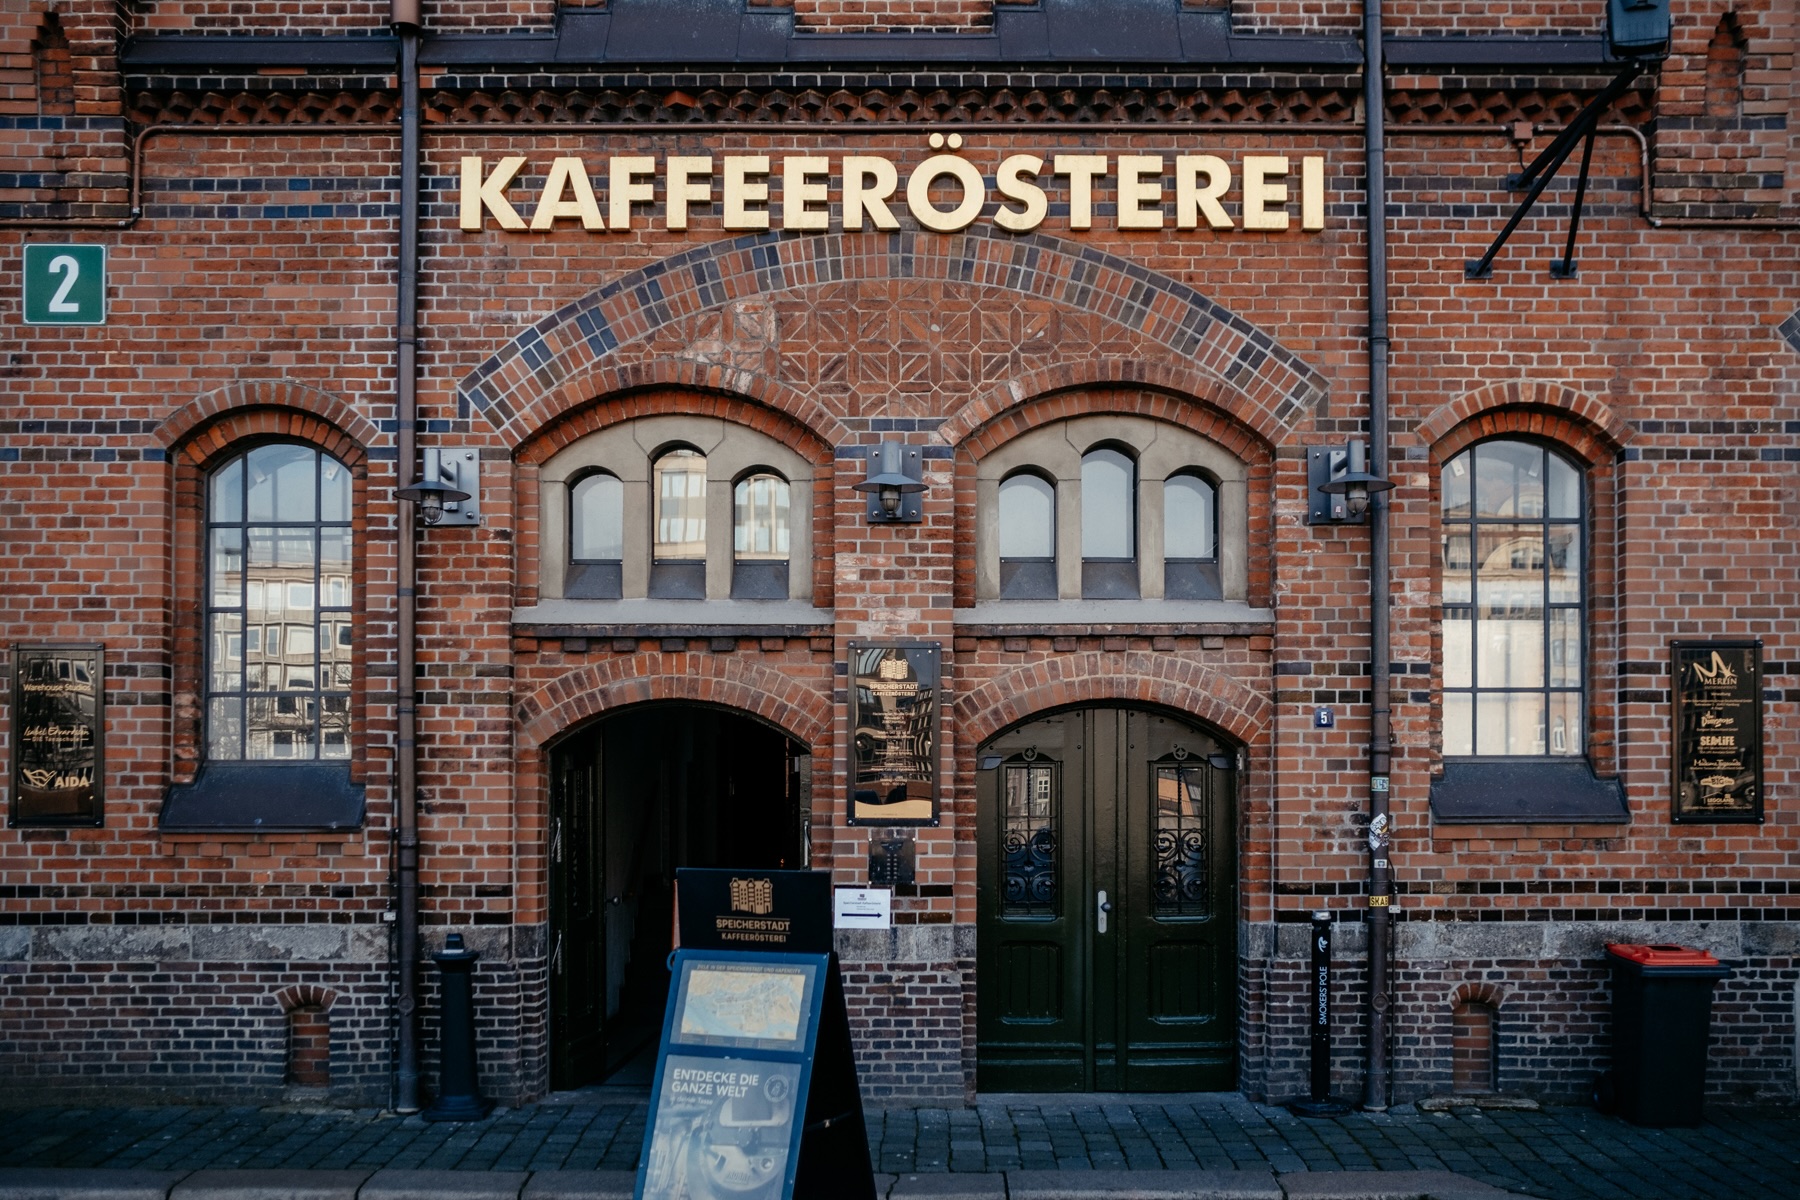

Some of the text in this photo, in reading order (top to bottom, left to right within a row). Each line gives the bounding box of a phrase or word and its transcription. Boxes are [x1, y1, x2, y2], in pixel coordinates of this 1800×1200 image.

[459, 132, 1326, 233] KAFFEERÖSTEREI
[48, 255, 79, 313] 2
[23, 683, 91, 691] Warehouse Studios
[1704, 677, 1737, 685] MERLIN
[1320, 711, 1328, 724] 5
[1700, 736, 1717, 746] SEA
[54, 776, 90, 788] AIDA
[716, 919, 791, 931] SPEICHERSTADT
[721, 932, 787, 943] KAFFEERÖSTEREI
[1319, 966, 1327, 985] POLE
[673, 1068, 760, 1087] ENTDECKE DIE
[671, 1081, 714, 1095] GANZE
[716, 1085, 749, 1098] WELT
